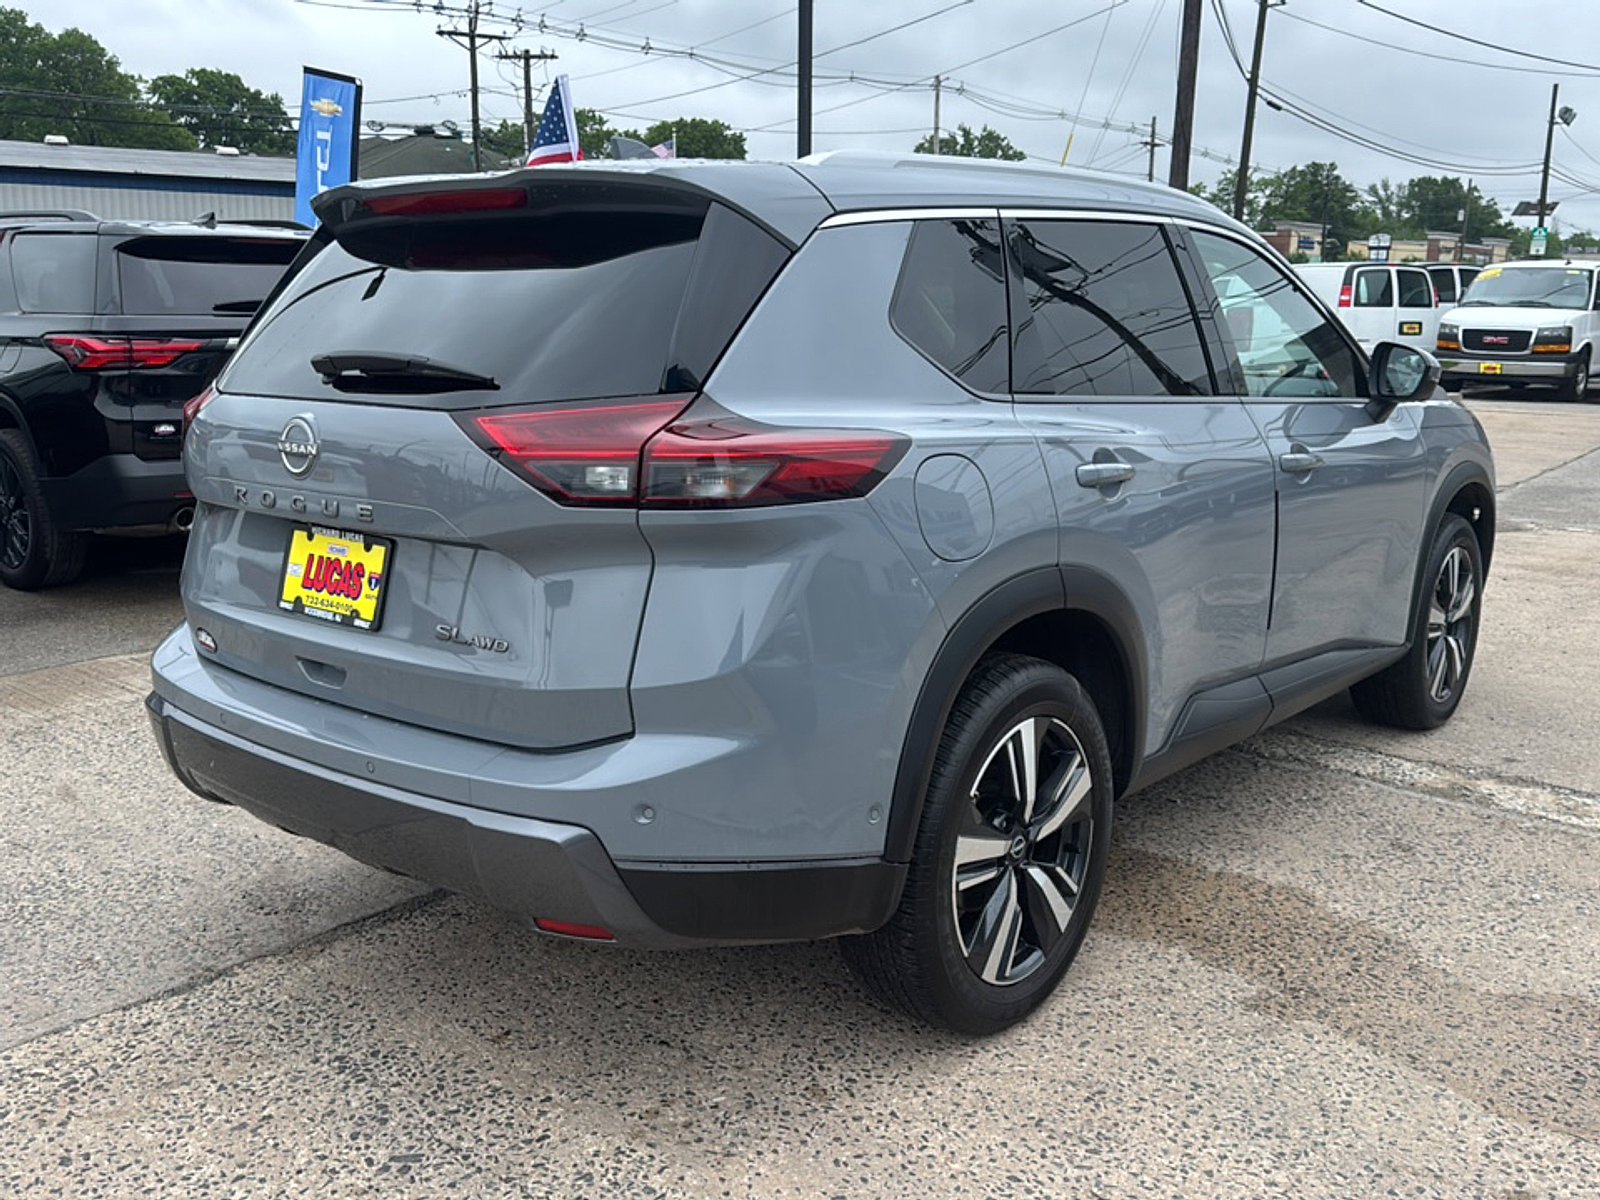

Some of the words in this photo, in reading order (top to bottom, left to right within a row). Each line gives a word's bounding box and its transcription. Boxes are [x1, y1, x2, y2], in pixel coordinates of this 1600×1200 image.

[233, 485, 373, 523] ROGUE
[301, 553, 366, 600] LUCAS
[435, 623, 467, 645] SL
[466, 634, 509, 653] AWD
